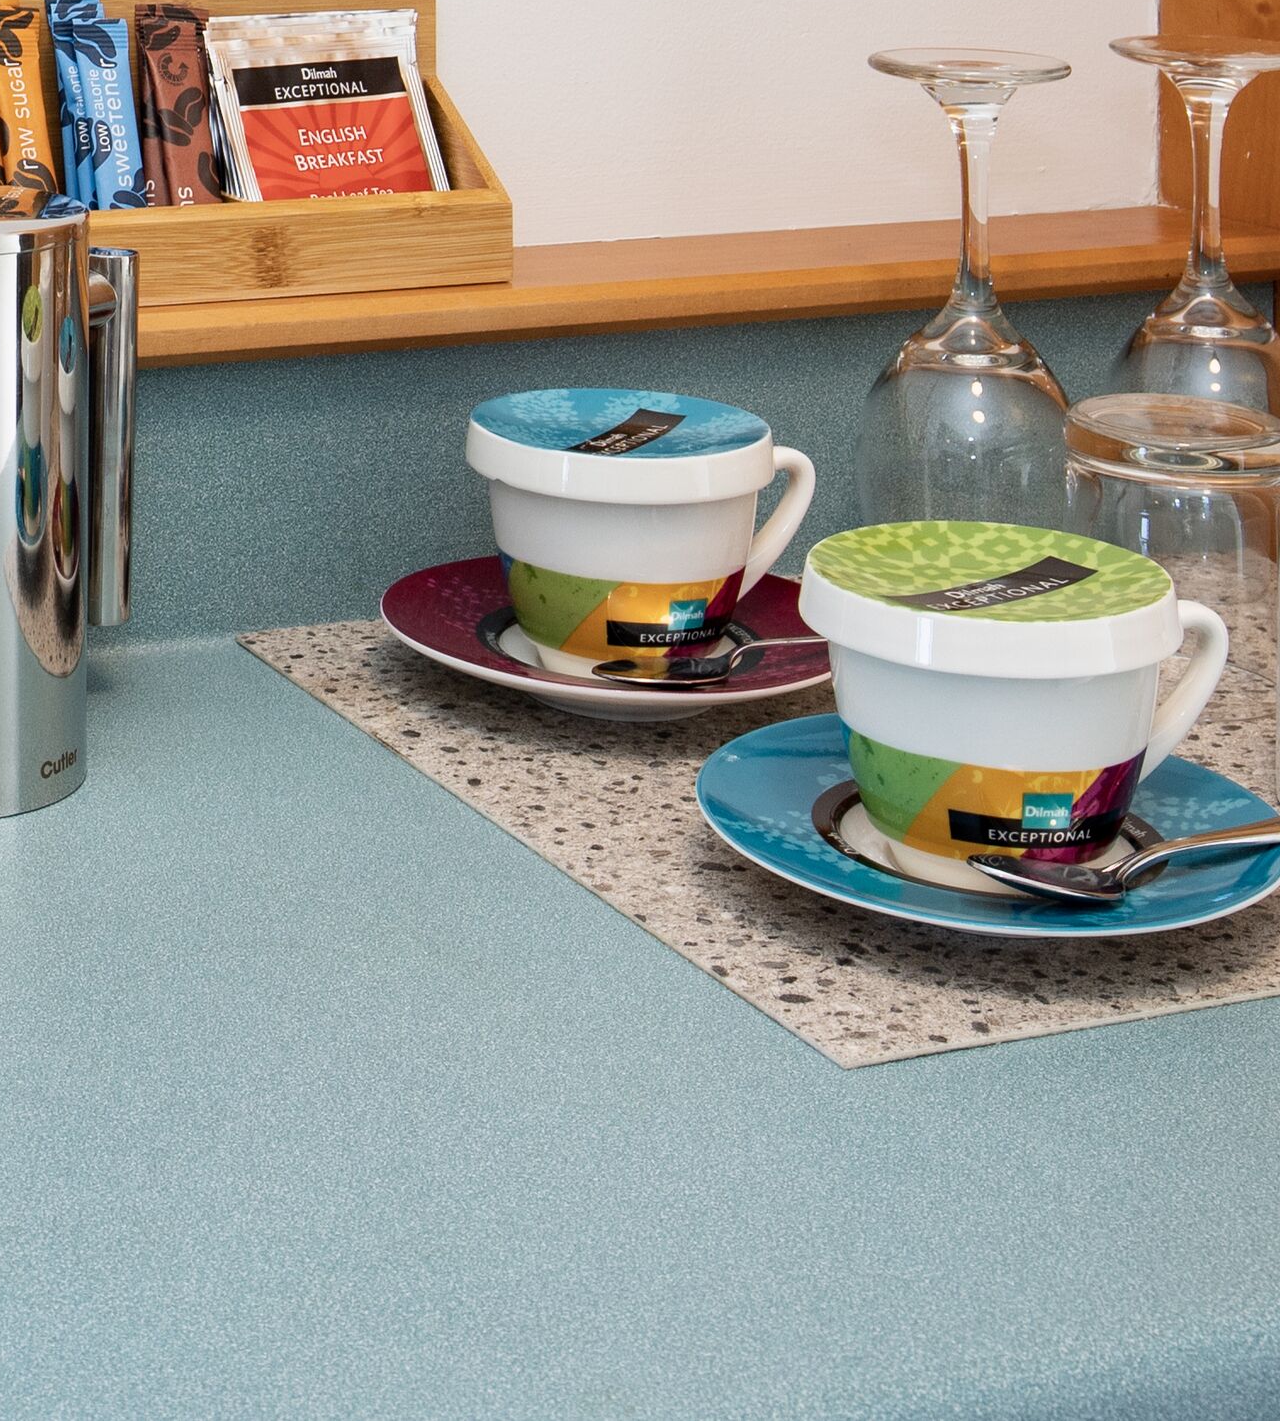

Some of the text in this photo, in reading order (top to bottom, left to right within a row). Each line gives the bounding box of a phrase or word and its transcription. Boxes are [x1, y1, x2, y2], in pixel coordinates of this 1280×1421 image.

[301, 67, 337, 81] Dilmah
[274, 81, 368, 100] EXCEPTIONAL
[78, 121, 91, 150] LOW
[96, 123, 111, 152] LOW
[298, 126, 367, 146] ENGLISH
[18, 127, 39, 170] raw
[294, 148, 384, 172] BREAKFAST
[944, 583, 1006, 600] Dilmah
[671, 611, 704, 623] Dilmah
[639, 627, 716, 644] EXCEPTIONAL
[40, 748, 77, 779] Cutler
[1024, 805, 1070, 819] Dilmah
[988, 828, 1092, 844] EXCEPTIONAL
